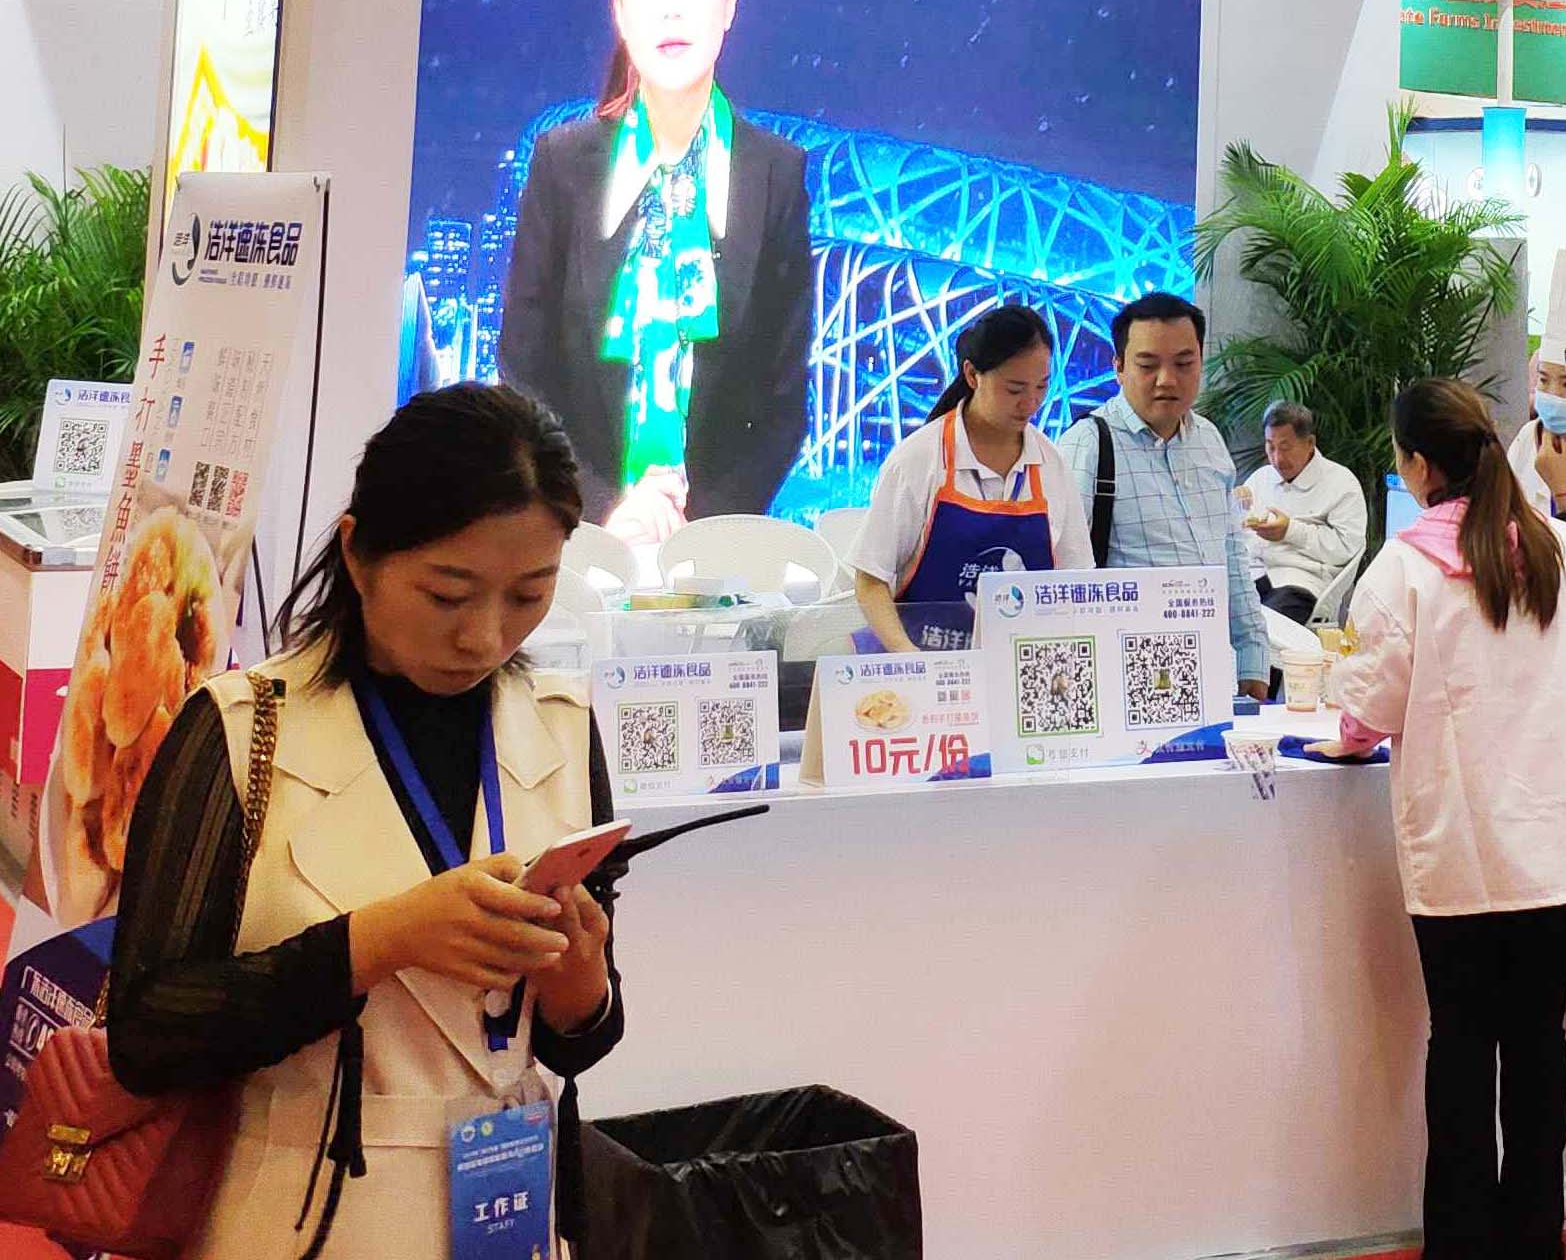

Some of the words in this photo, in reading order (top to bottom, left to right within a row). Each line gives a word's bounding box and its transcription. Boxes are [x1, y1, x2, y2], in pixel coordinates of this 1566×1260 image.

[204, 219, 303, 266] 浩洋速冻食品
[1035, 581, 1139, 605] 浩洋速冻食品
[633, 661, 712, 680] 浩洋速冻食品
[849, 733, 969, 776] 10元/份
[473, 1190, 530, 1223] 工作证
